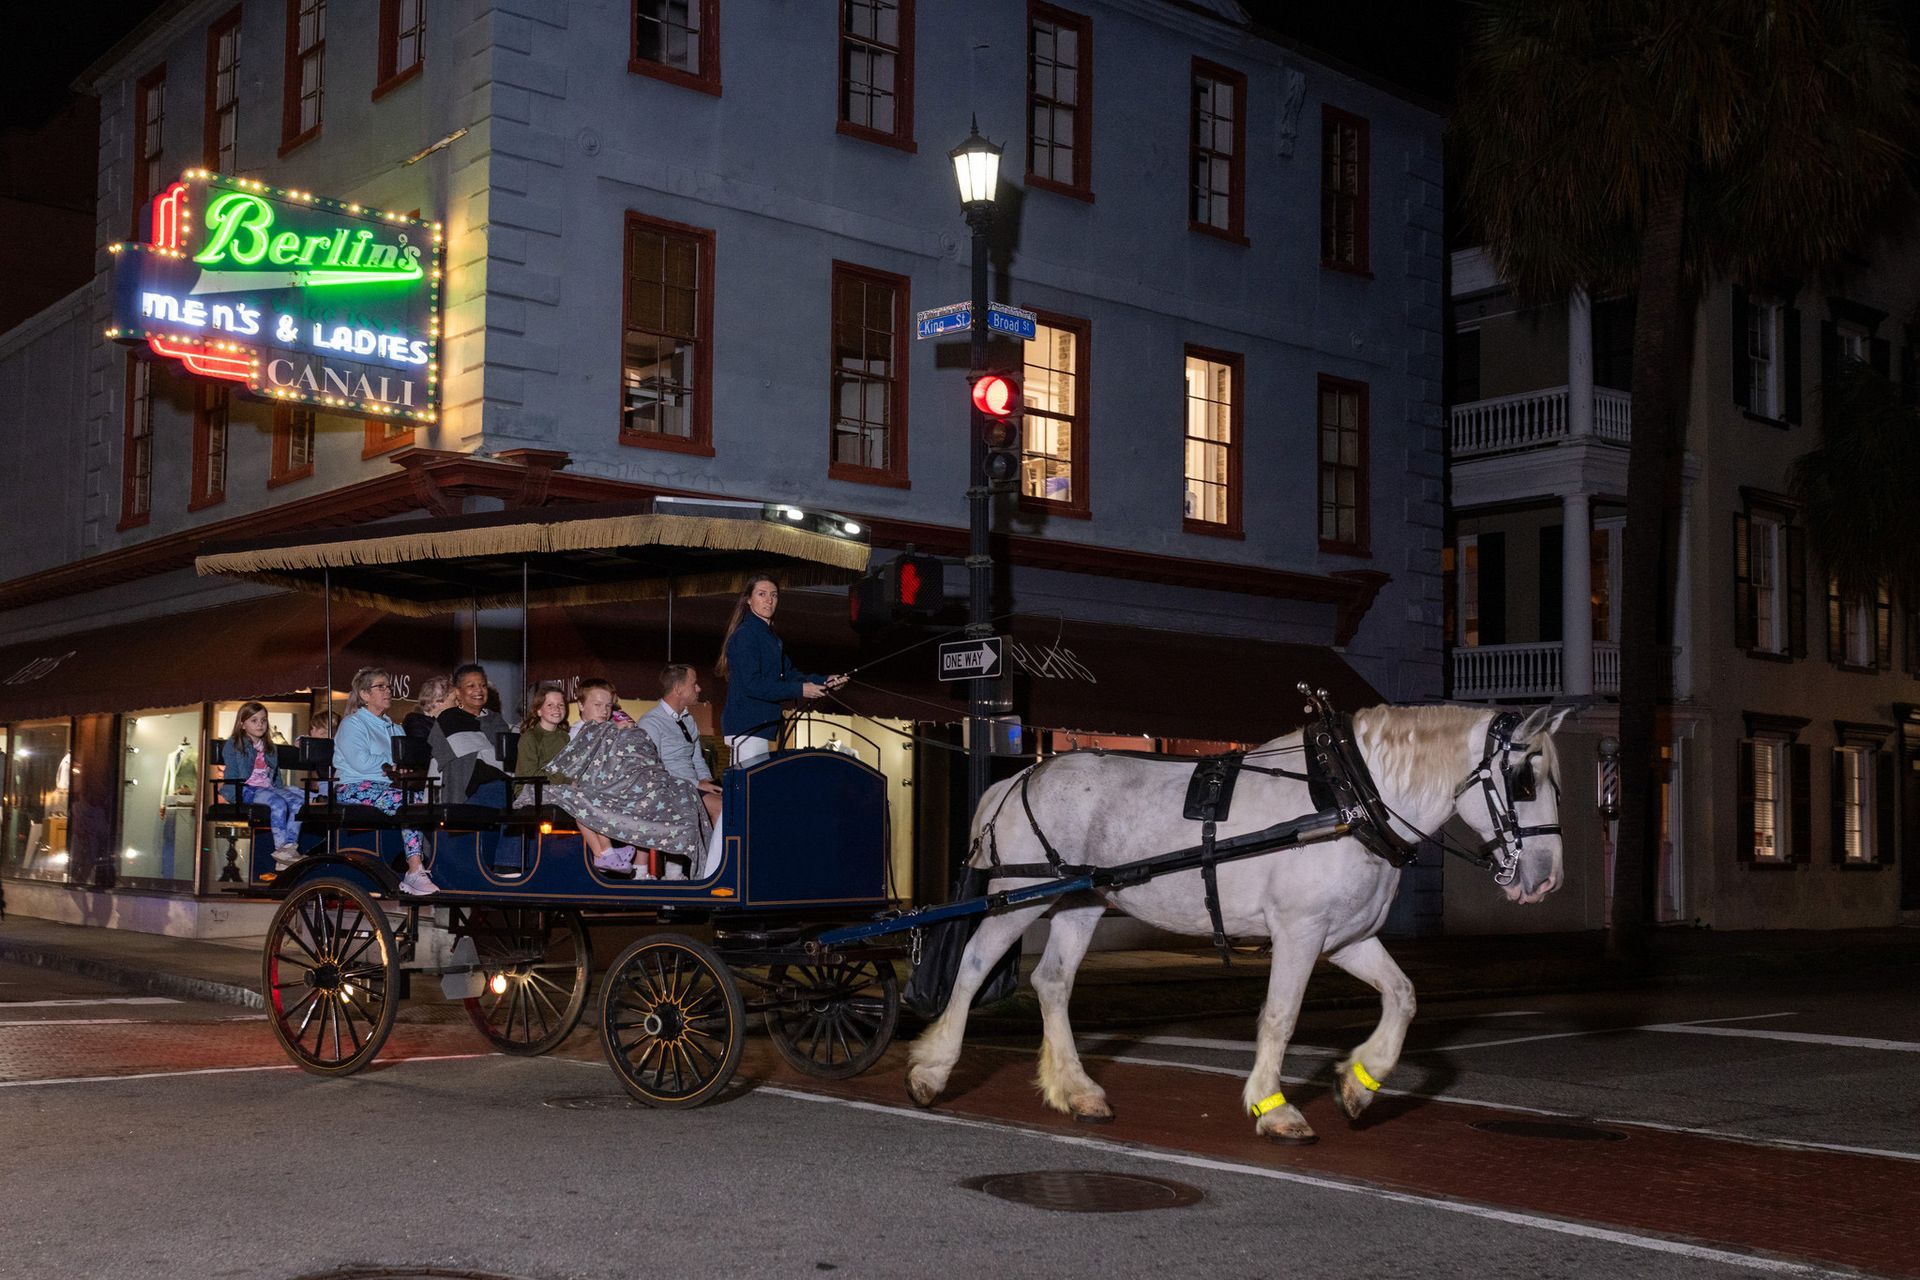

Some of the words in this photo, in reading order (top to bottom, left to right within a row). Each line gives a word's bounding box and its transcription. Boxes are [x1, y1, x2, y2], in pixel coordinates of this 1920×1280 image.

[193, 192, 421, 270] Berlin's
[276, 314, 299, 343] &
[312, 322, 429, 365] LADIES
[924, 320, 944, 335] King
[955, 313, 966, 328] St
[993, 313, 1020, 332] Broad
[1022, 320, 1030, 331] St
[267, 358, 415, 407] CANALI
[945, 654, 962, 669] ONE
[965, 651, 983, 667] WAY
